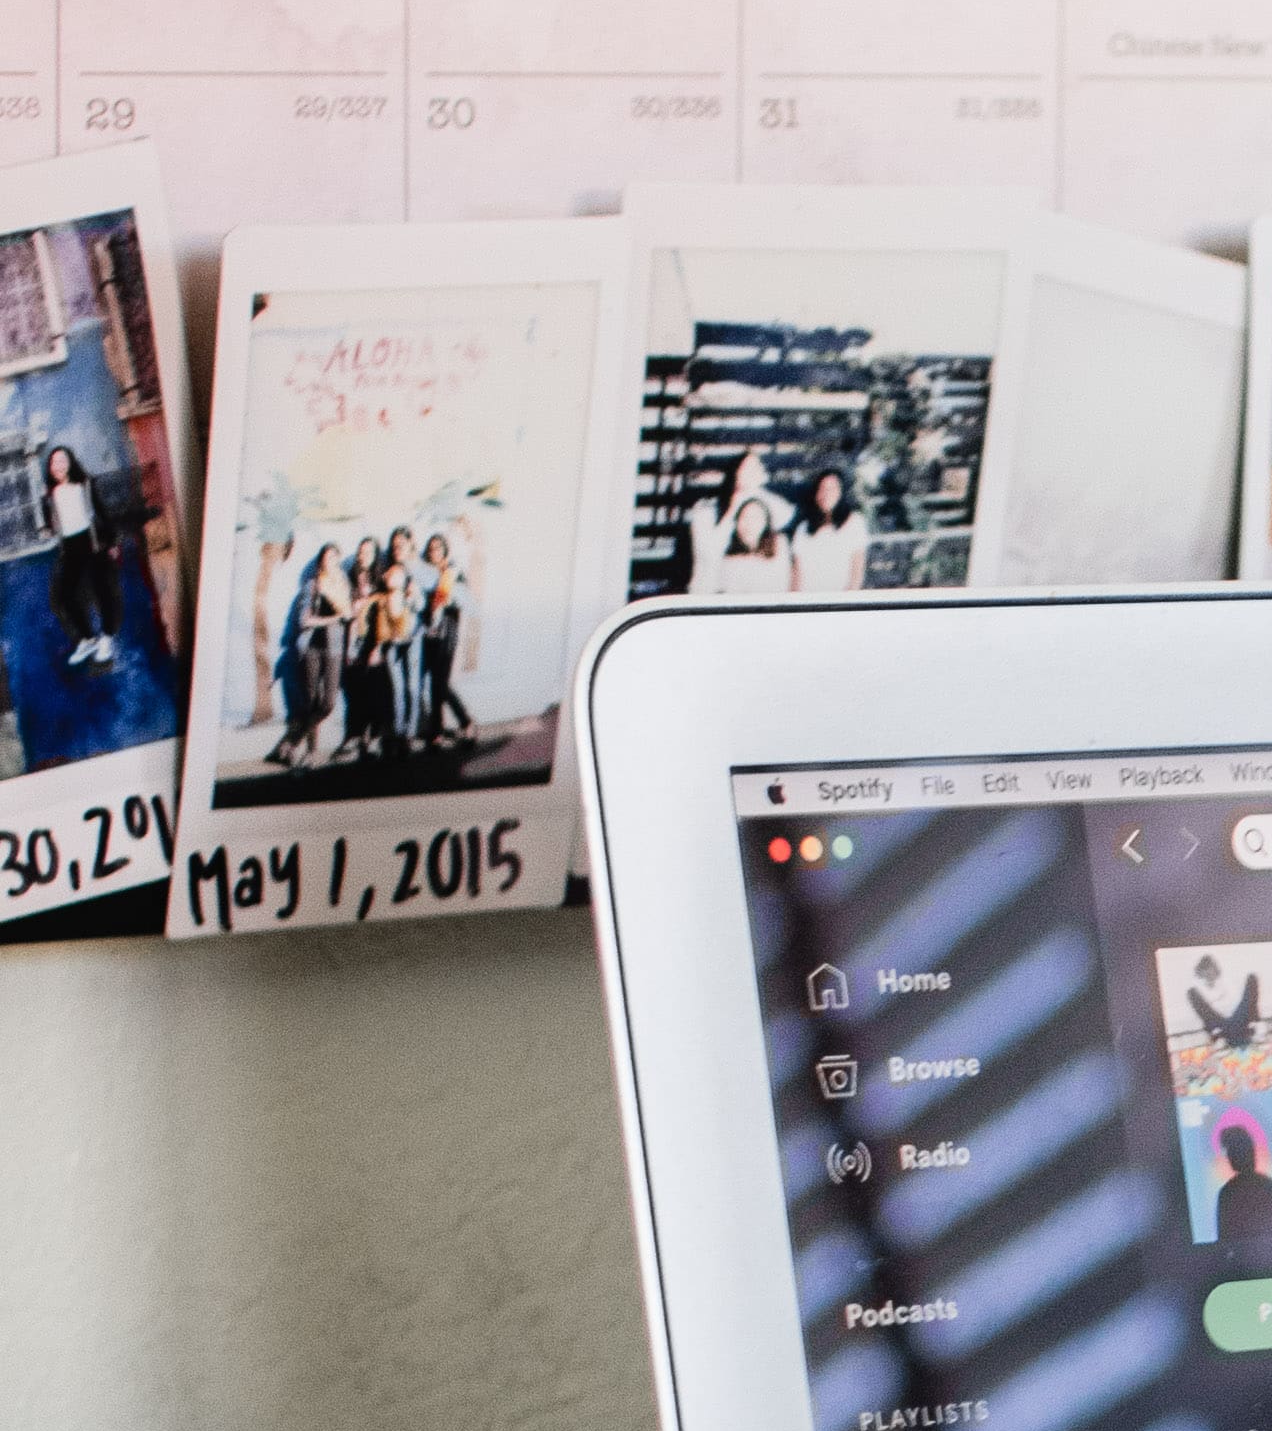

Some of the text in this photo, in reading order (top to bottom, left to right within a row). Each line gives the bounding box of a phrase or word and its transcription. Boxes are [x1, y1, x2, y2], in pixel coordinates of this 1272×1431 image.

[85, 97, 136, 131] 29
[427, 96, 476, 131] 30
[759, 97, 800, 130] 31
[817, 779, 894, 804] Spotify
[920, 775, 956, 796] File
[982, 773, 1022, 794] Edit
[1046, 769, 1093, 791] View
[1119, 766, 1205, 792] Playback
[186, 818, 522, 932] May 1, 2015
[878, 968, 952, 995] Home
[887, 1056, 981, 1084] Browse
[899, 1141, 971, 1171] Radio
[845, 1297, 959, 1330] Podcasts
